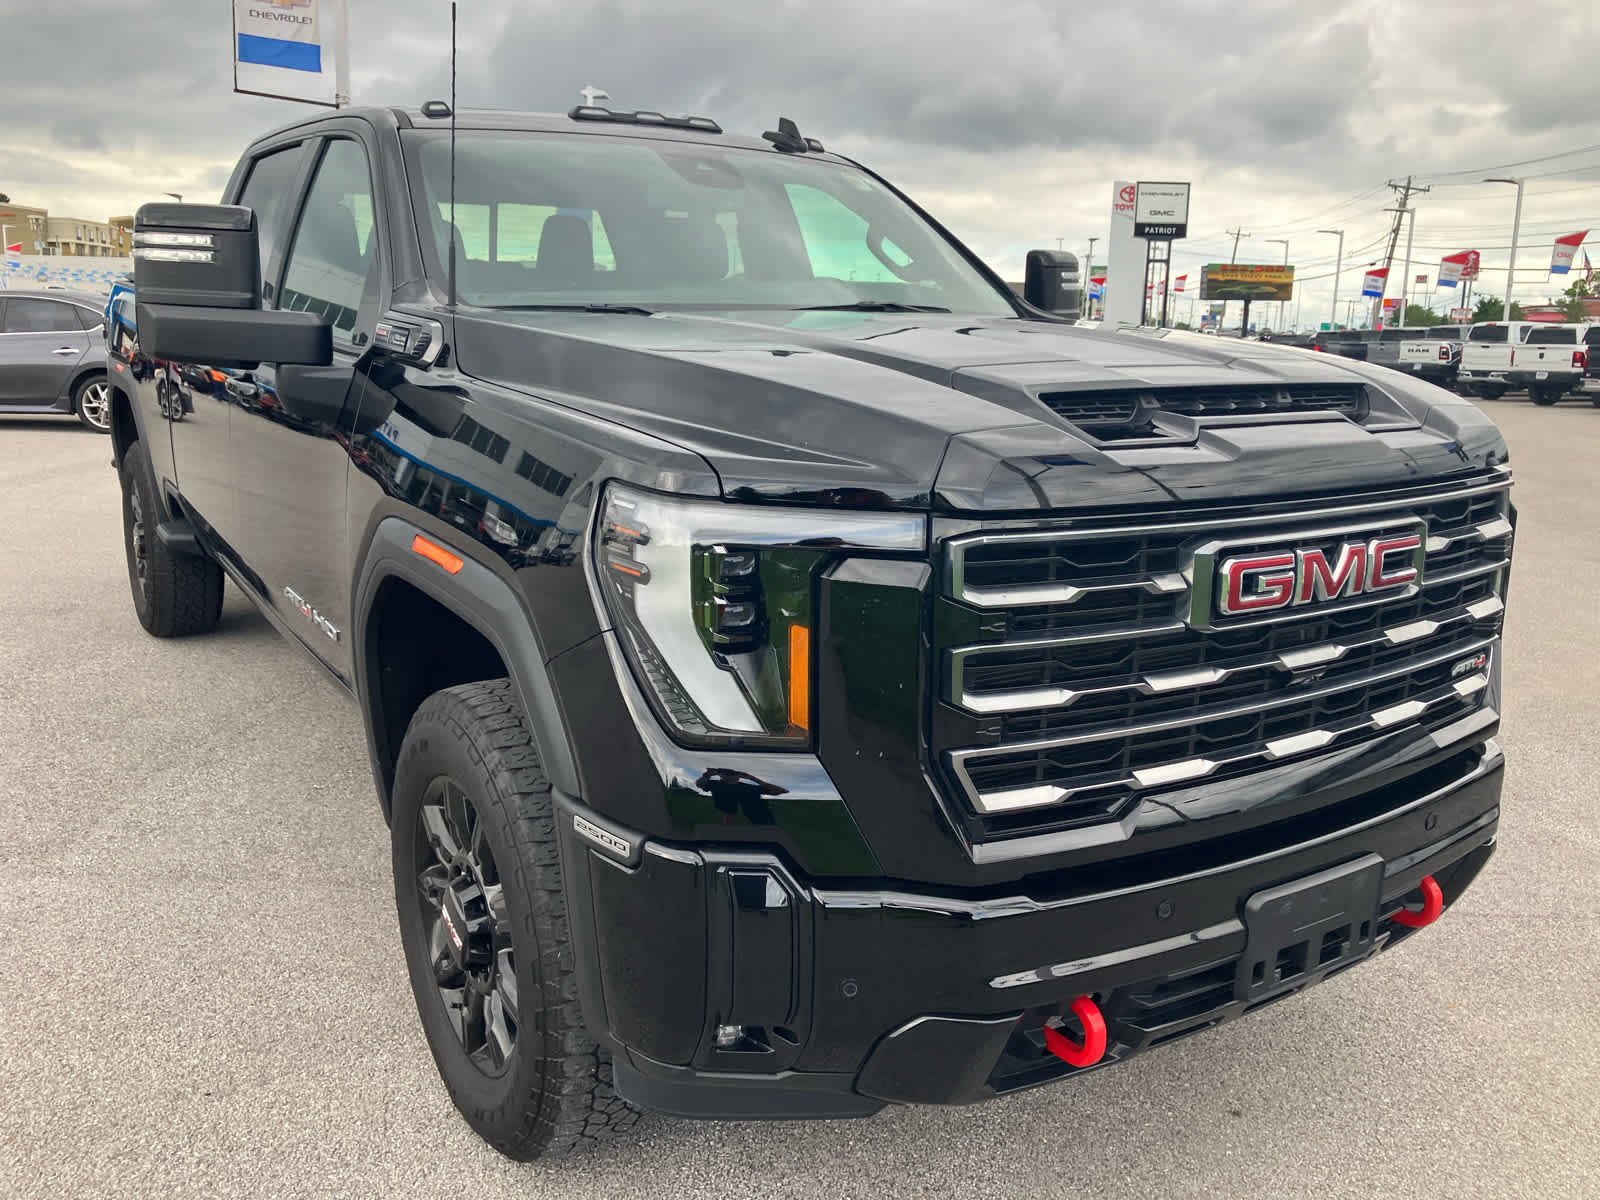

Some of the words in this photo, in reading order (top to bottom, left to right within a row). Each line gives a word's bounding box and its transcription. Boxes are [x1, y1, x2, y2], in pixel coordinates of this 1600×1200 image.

[249, 9, 313, 25] CHEVROLET
[1145, 226, 1176, 234] PATRIOT
[1219, 534, 1421, 616] GMC
[576, 820, 626, 851] 2500
